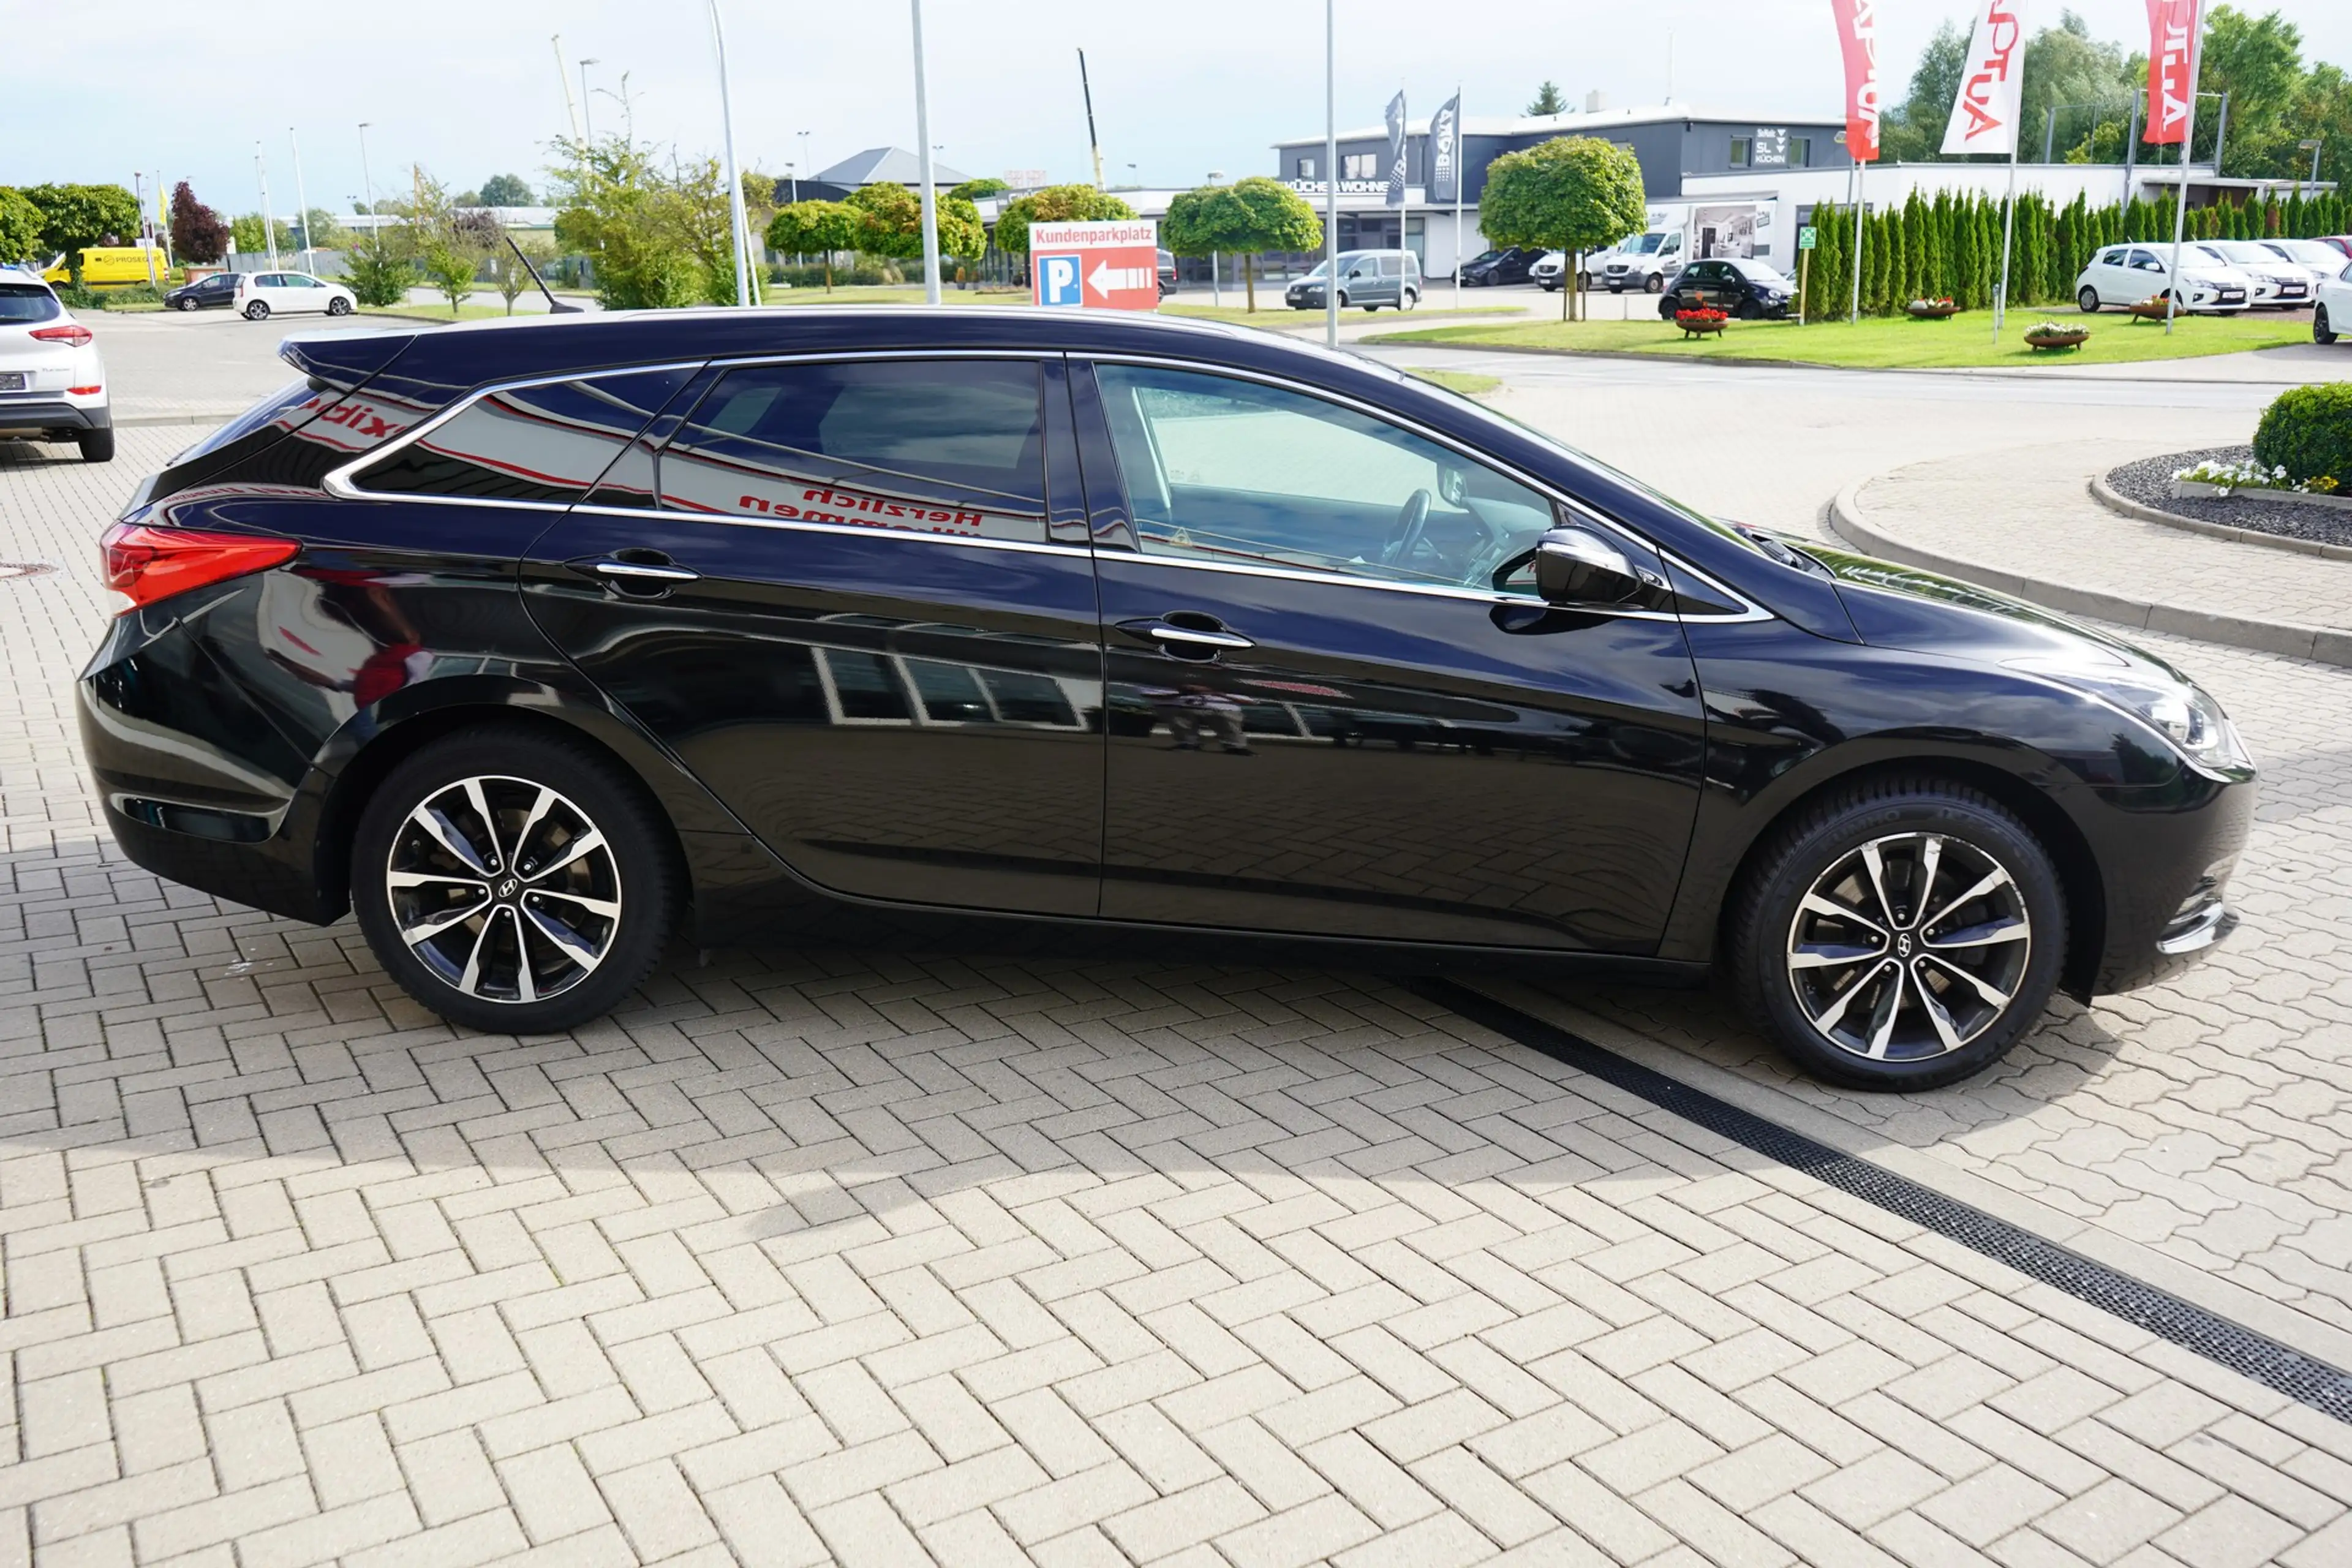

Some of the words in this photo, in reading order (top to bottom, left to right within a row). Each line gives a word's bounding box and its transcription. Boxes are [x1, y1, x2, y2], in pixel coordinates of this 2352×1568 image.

[1757, 141, 1771, 153] SL
[1340, 181, 1390, 192] WOHNE
[1036, 227, 1152, 245] Kundenparkplatz
[1047, 259, 1074, 303] P
